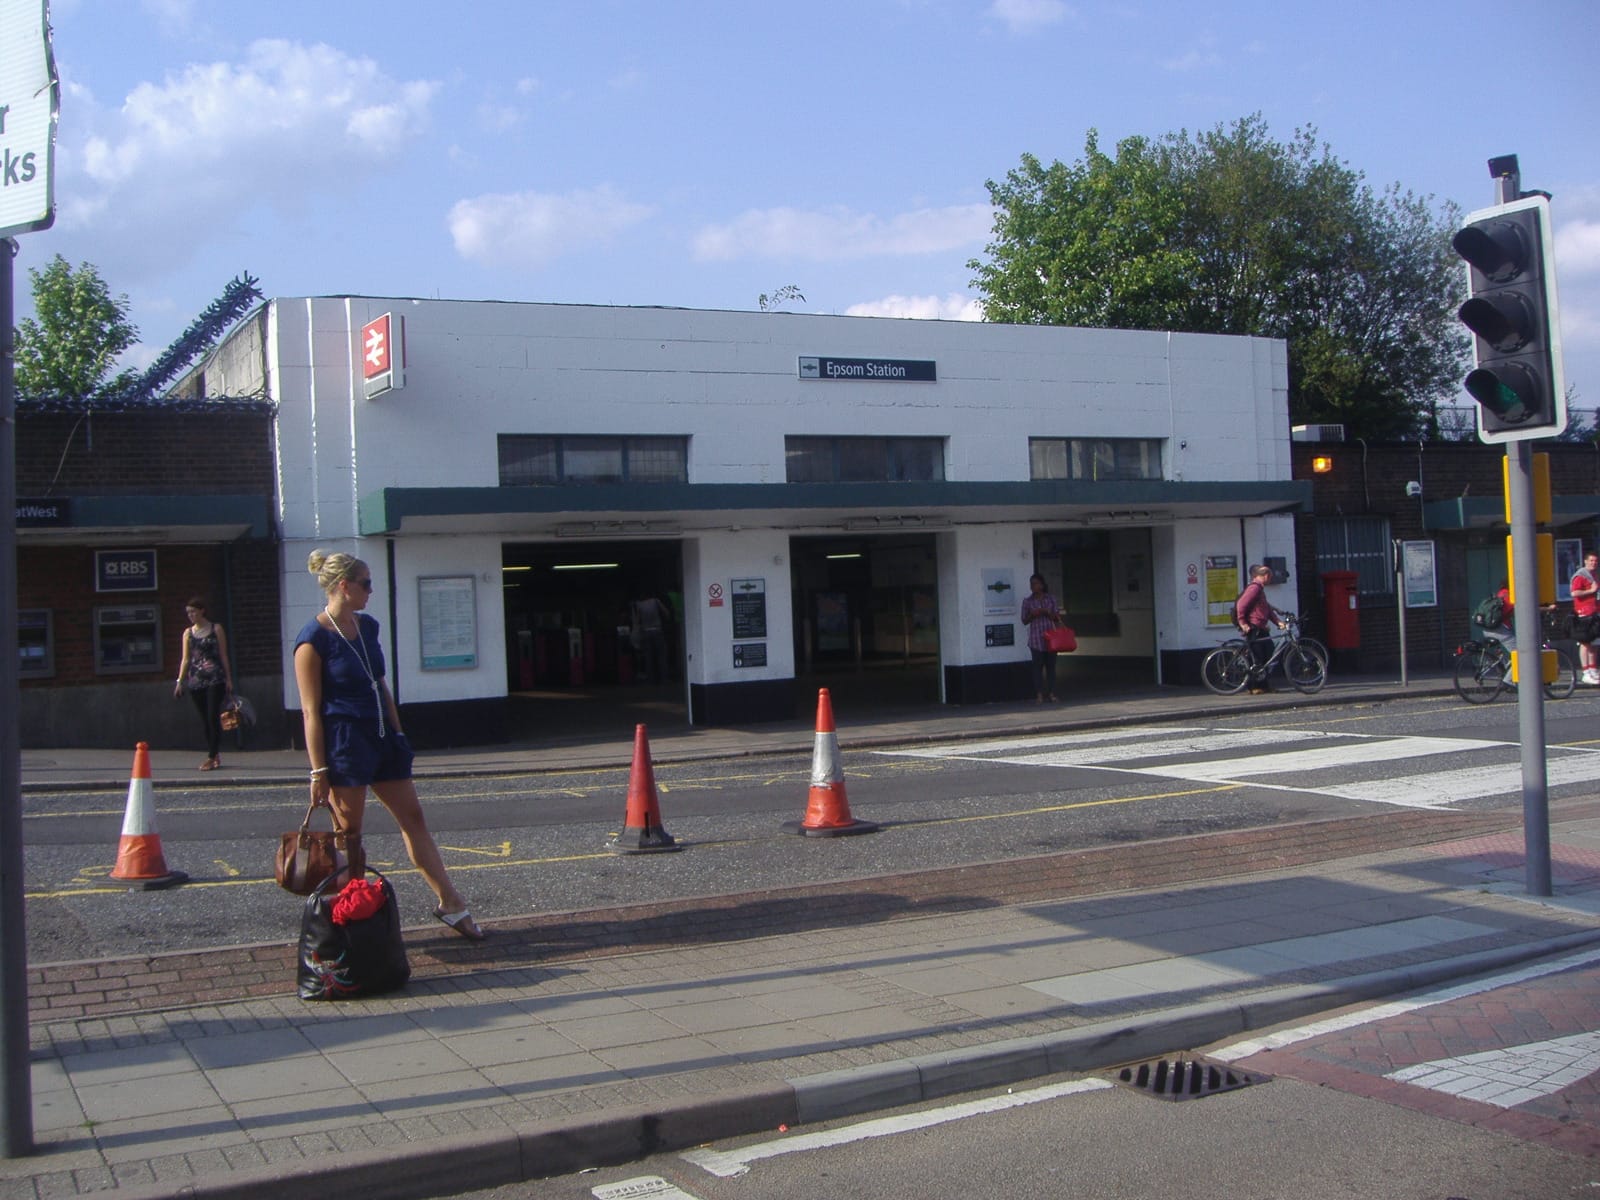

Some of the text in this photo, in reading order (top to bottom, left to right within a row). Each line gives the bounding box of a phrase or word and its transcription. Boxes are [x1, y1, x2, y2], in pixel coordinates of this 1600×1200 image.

[0, 147, 36, 187] ks
[826, 361, 906, 378] Epsom Station
[120, 560, 148, 575] RBS
